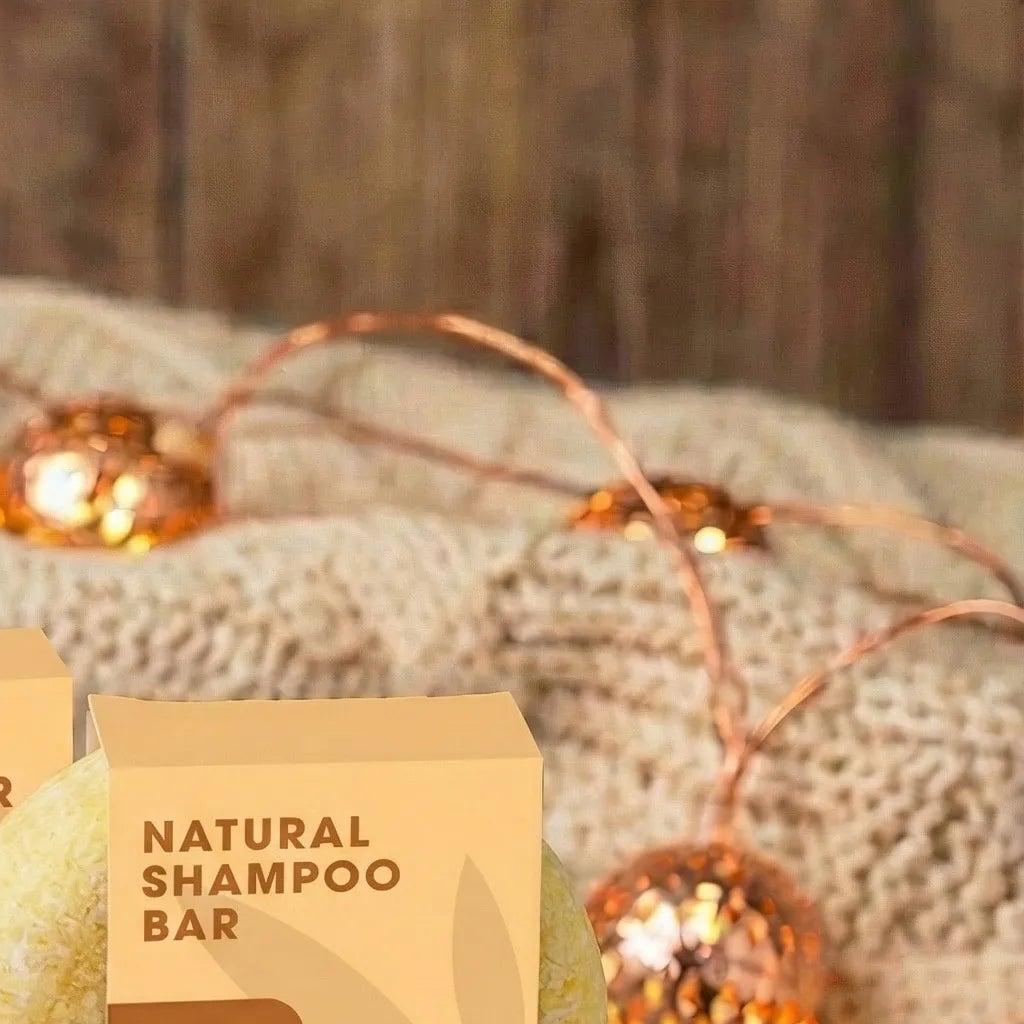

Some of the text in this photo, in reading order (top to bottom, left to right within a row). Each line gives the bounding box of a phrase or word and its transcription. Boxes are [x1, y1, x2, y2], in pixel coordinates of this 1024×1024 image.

[143, 815, 370, 854] NATURAL
[141, 858, 401, 898] SHAMPOO
[143, 907, 239, 942] BAR
